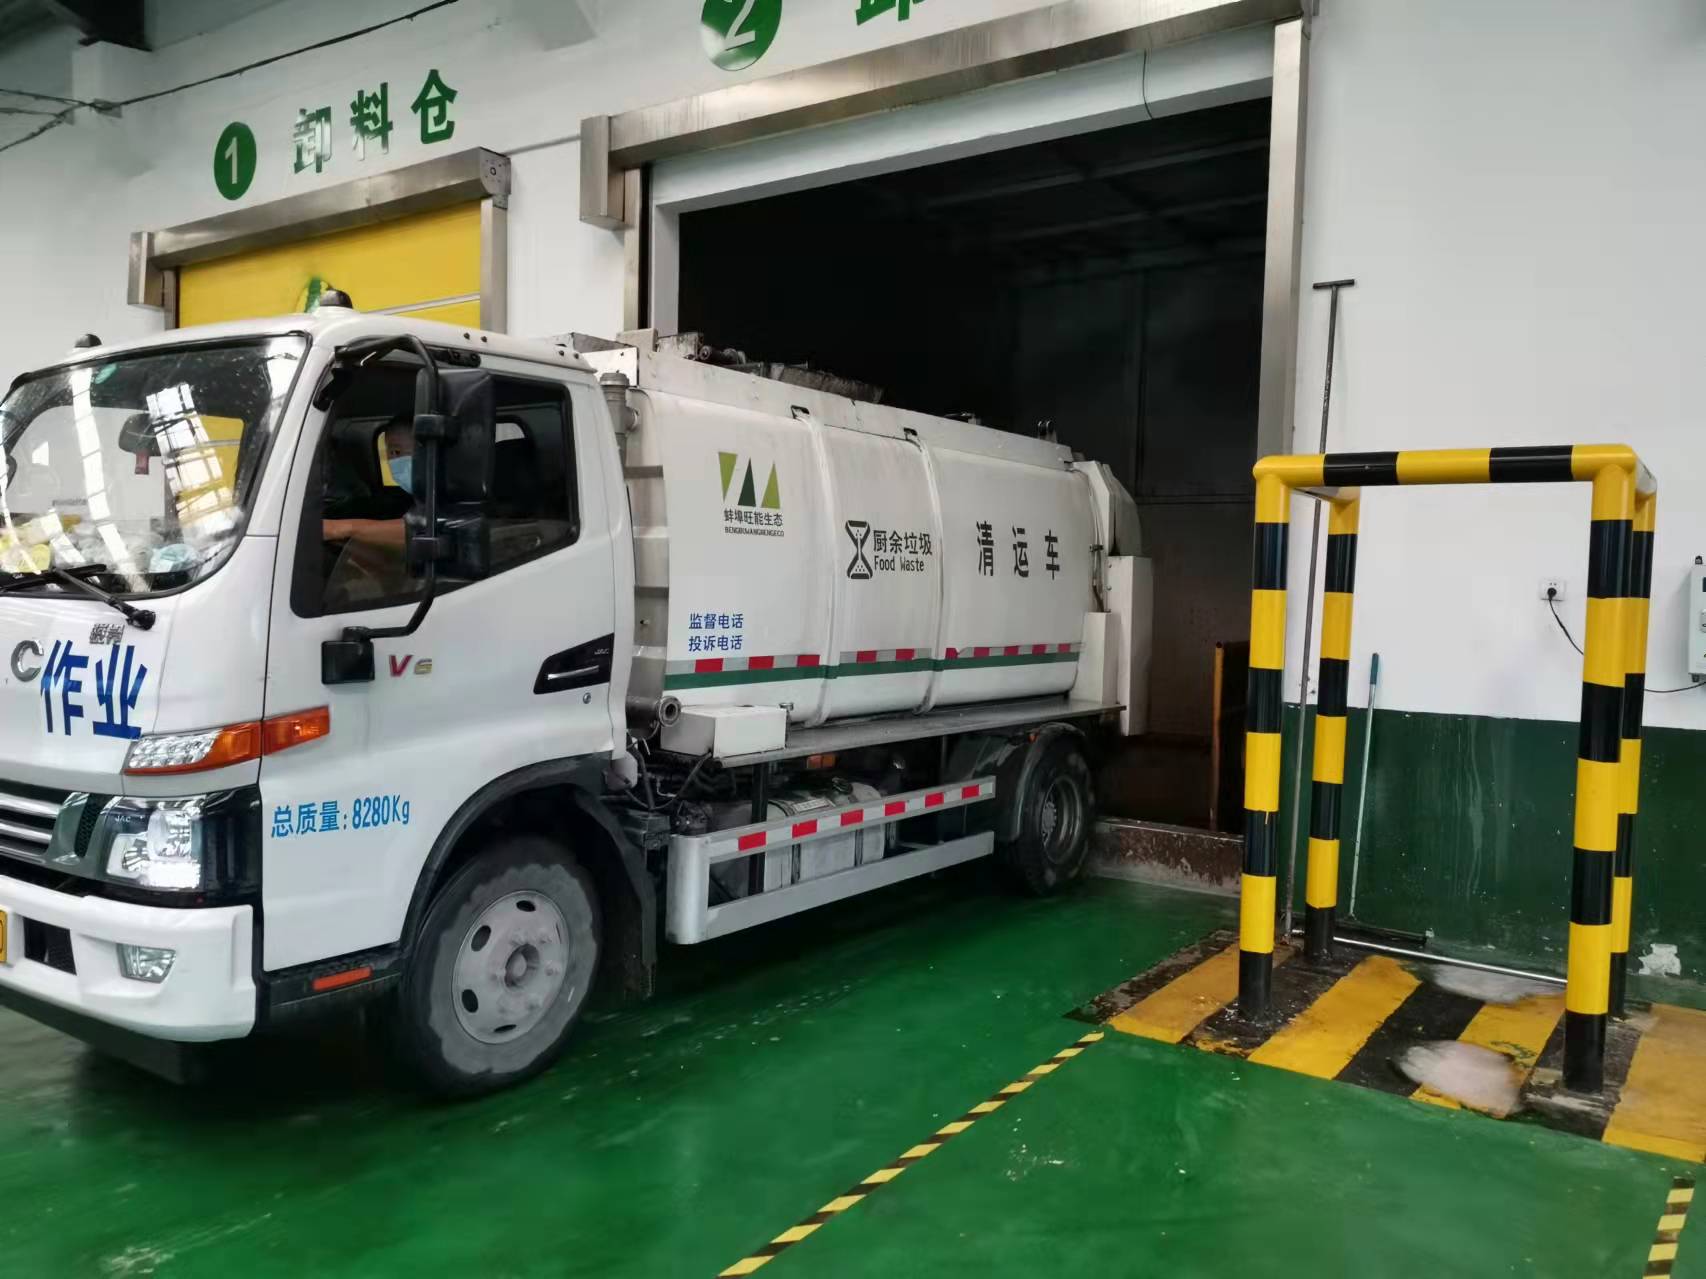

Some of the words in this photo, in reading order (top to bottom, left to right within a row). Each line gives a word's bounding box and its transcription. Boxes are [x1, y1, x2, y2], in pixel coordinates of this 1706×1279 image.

[293, 68, 458, 175] 卸料仓
[723, 507, 784, 527] 蚌埠旺能生态
[873, 529, 933, 556] 厨余垃圾
[976, 520, 1060, 580] 清运车
[874, 555, 896, 571] Food
[900, 556, 925, 571] Waste
[688, 612, 744, 630] 监督电话
[688, 634, 743, 652] 投诉电话
[41, 639, 148, 741] 作业
